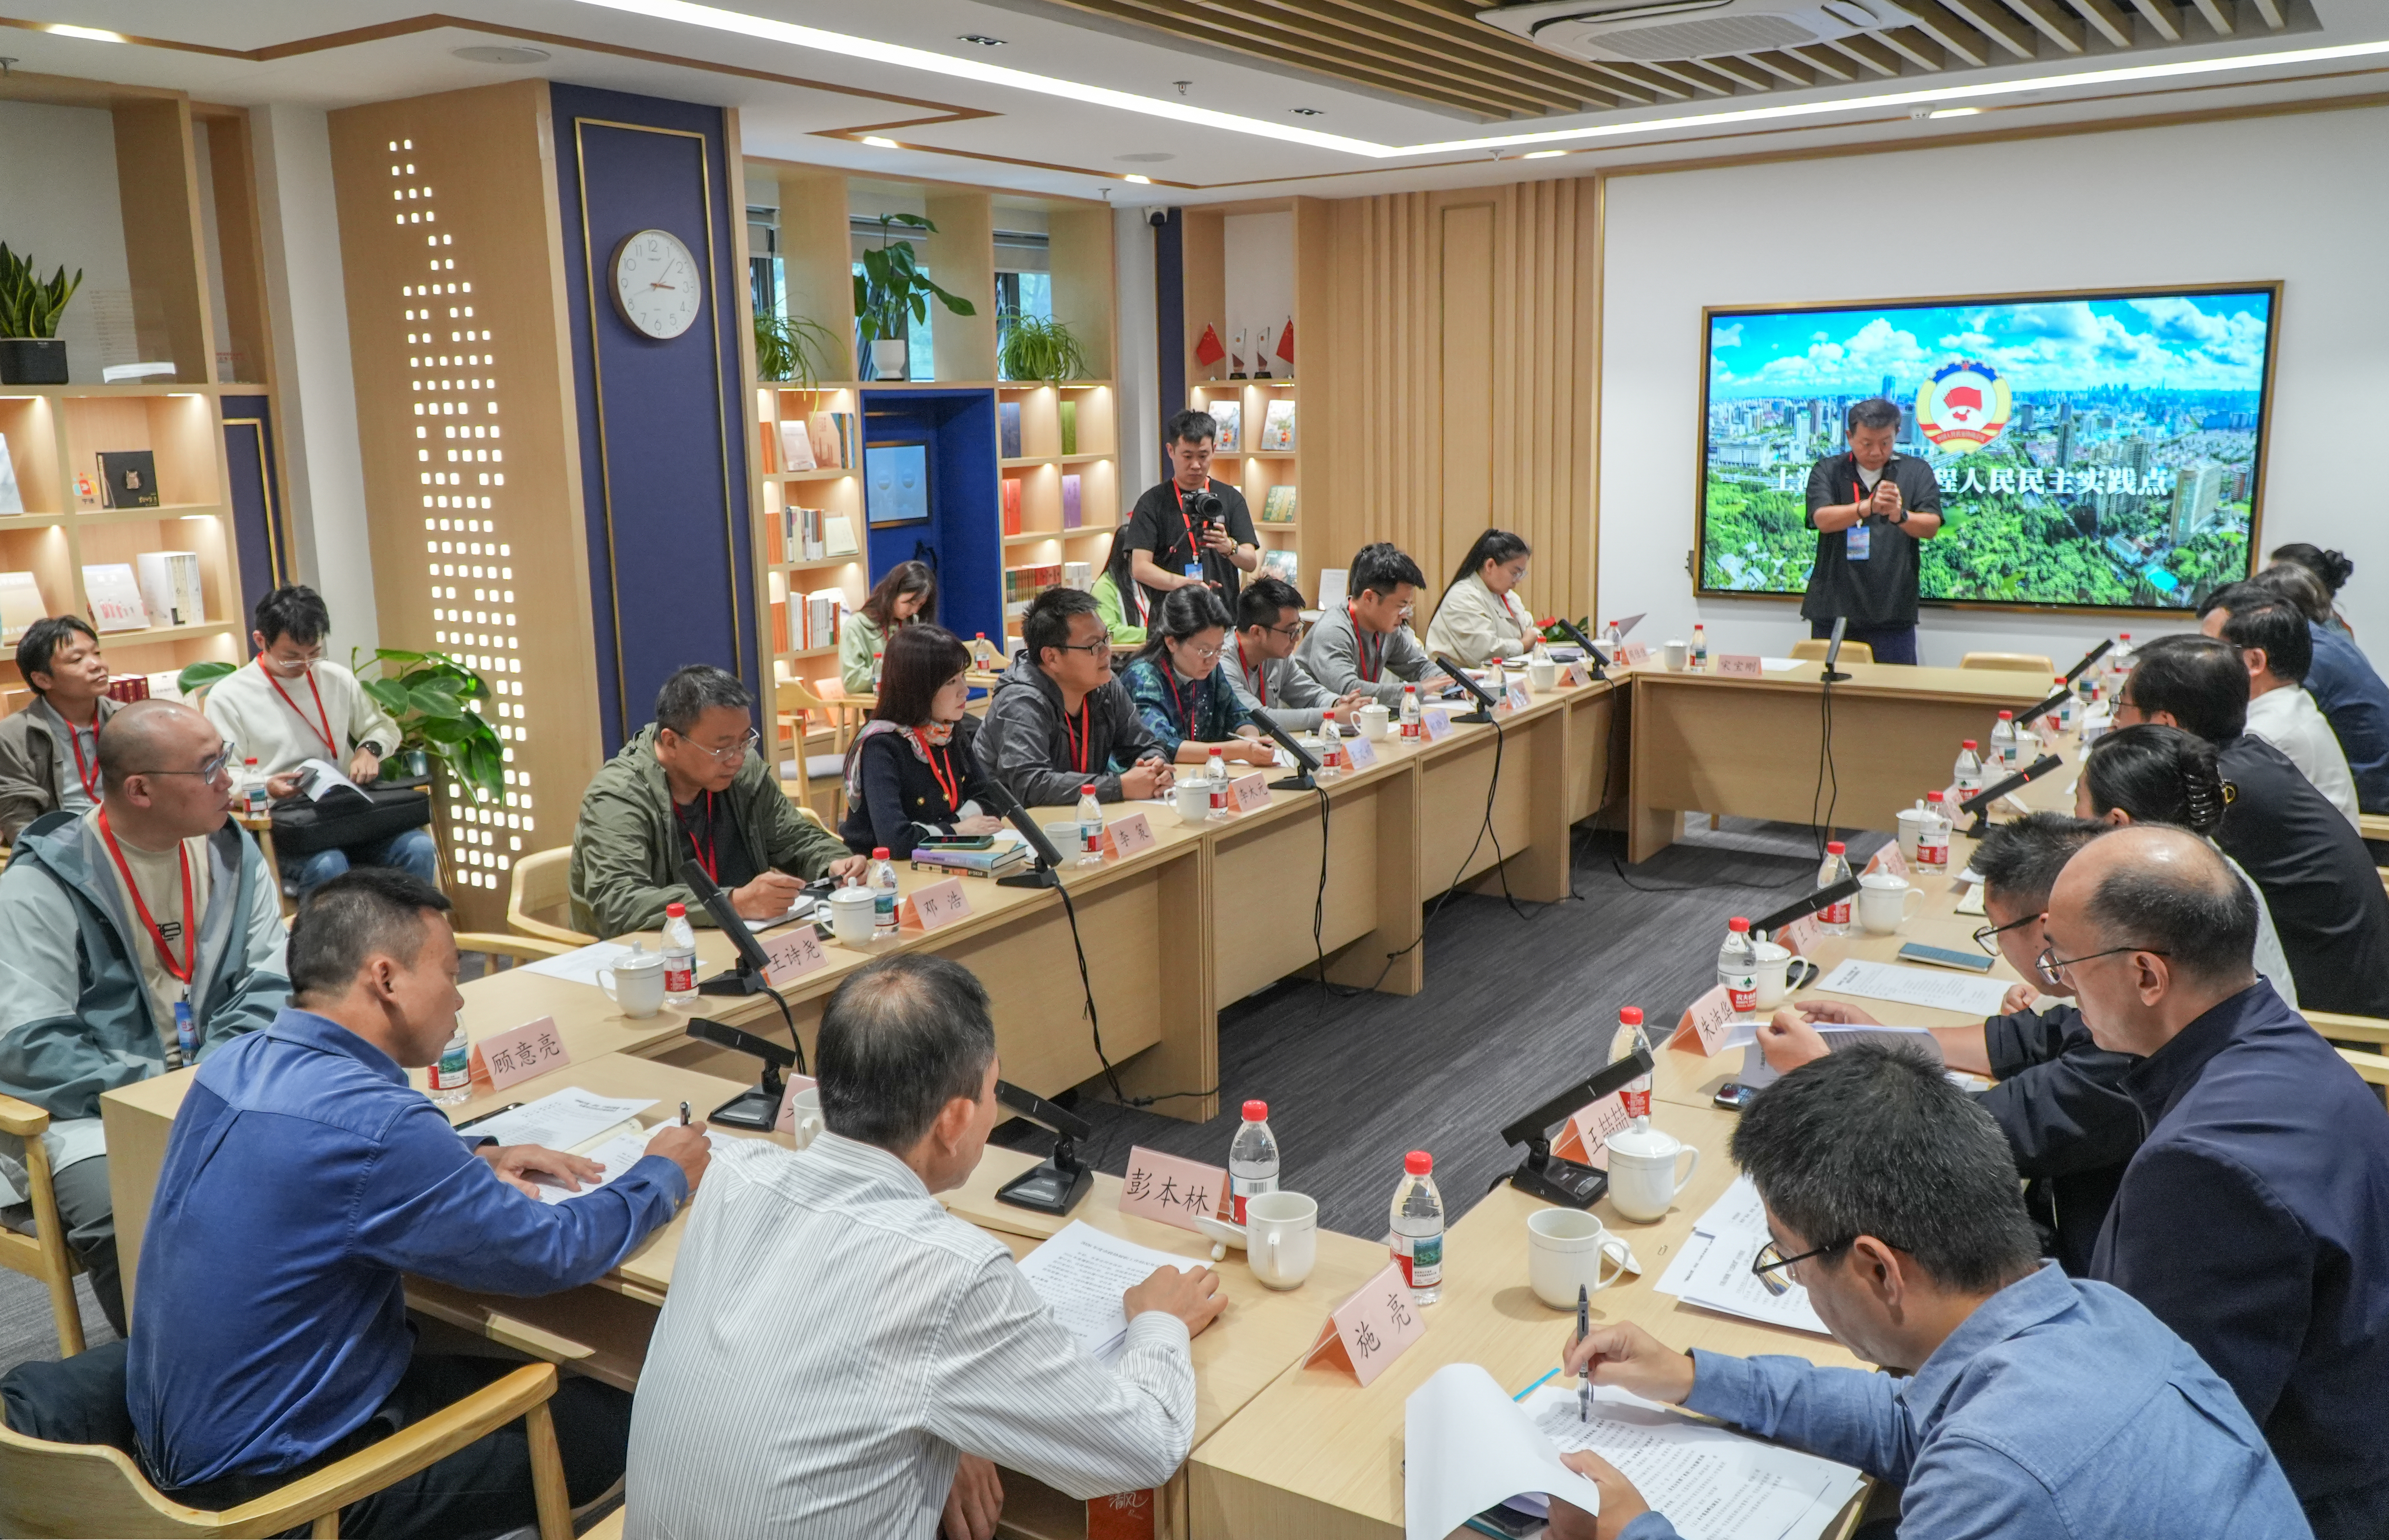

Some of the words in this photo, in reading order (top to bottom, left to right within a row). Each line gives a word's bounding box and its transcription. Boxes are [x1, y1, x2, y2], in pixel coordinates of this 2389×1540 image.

[635, 244, 642, 257] 11
[648, 239, 657, 252] 12
[666, 246, 669, 258] 1
[623, 258, 636, 271] 10
[676, 261, 684, 274] 2
[621, 278, 628, 289] 9
[683, 281, 689, 293] 3
[628, 299, 634, 311] 8
[680, 301, 685, 311] 4
[640, 312, 646, 324] 7
[669, 314, 677, 326] 5
[654, 319, 662, 331] 6
[491, 1033, 561, 1076] 顾意亮
[1126, 1168, 1210, 1214] 彭本林
[1356, 1292, 1411, 1360] 施亮
